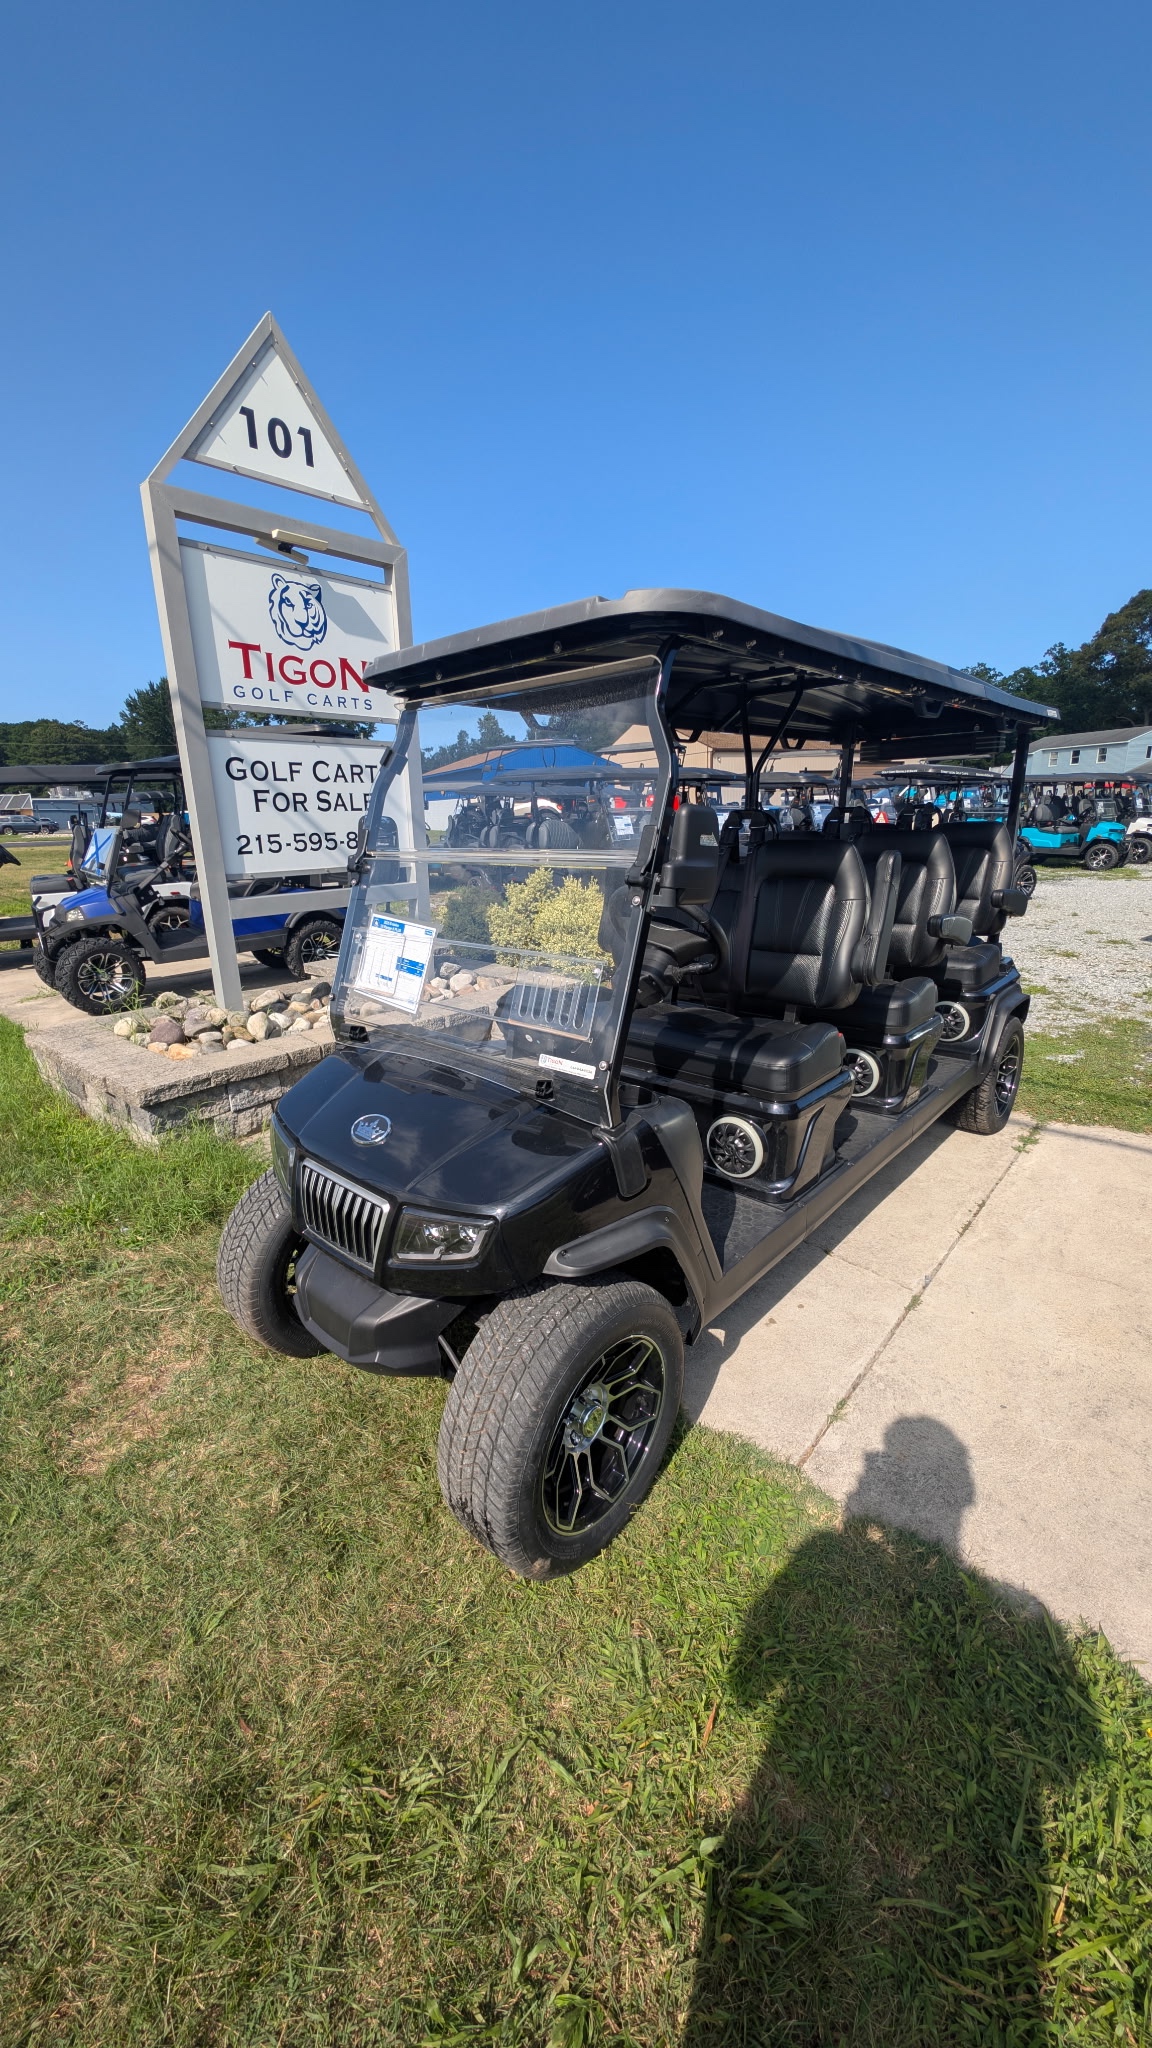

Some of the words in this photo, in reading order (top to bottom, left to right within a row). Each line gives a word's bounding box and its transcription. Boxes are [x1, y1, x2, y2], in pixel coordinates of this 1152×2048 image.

[239, 406, 314, 468] 101
[228, 639, 370, 693] TIGON
[233, 685, 293, 702] GOLF
[307, 693, 373, 710] CARTS
[225, 756, 303, 782] GOLF
[312, 760, 378, 783] CART
[253, 789, 309, 812] FOR
[235, 831, 358, 856] 215-595-8
